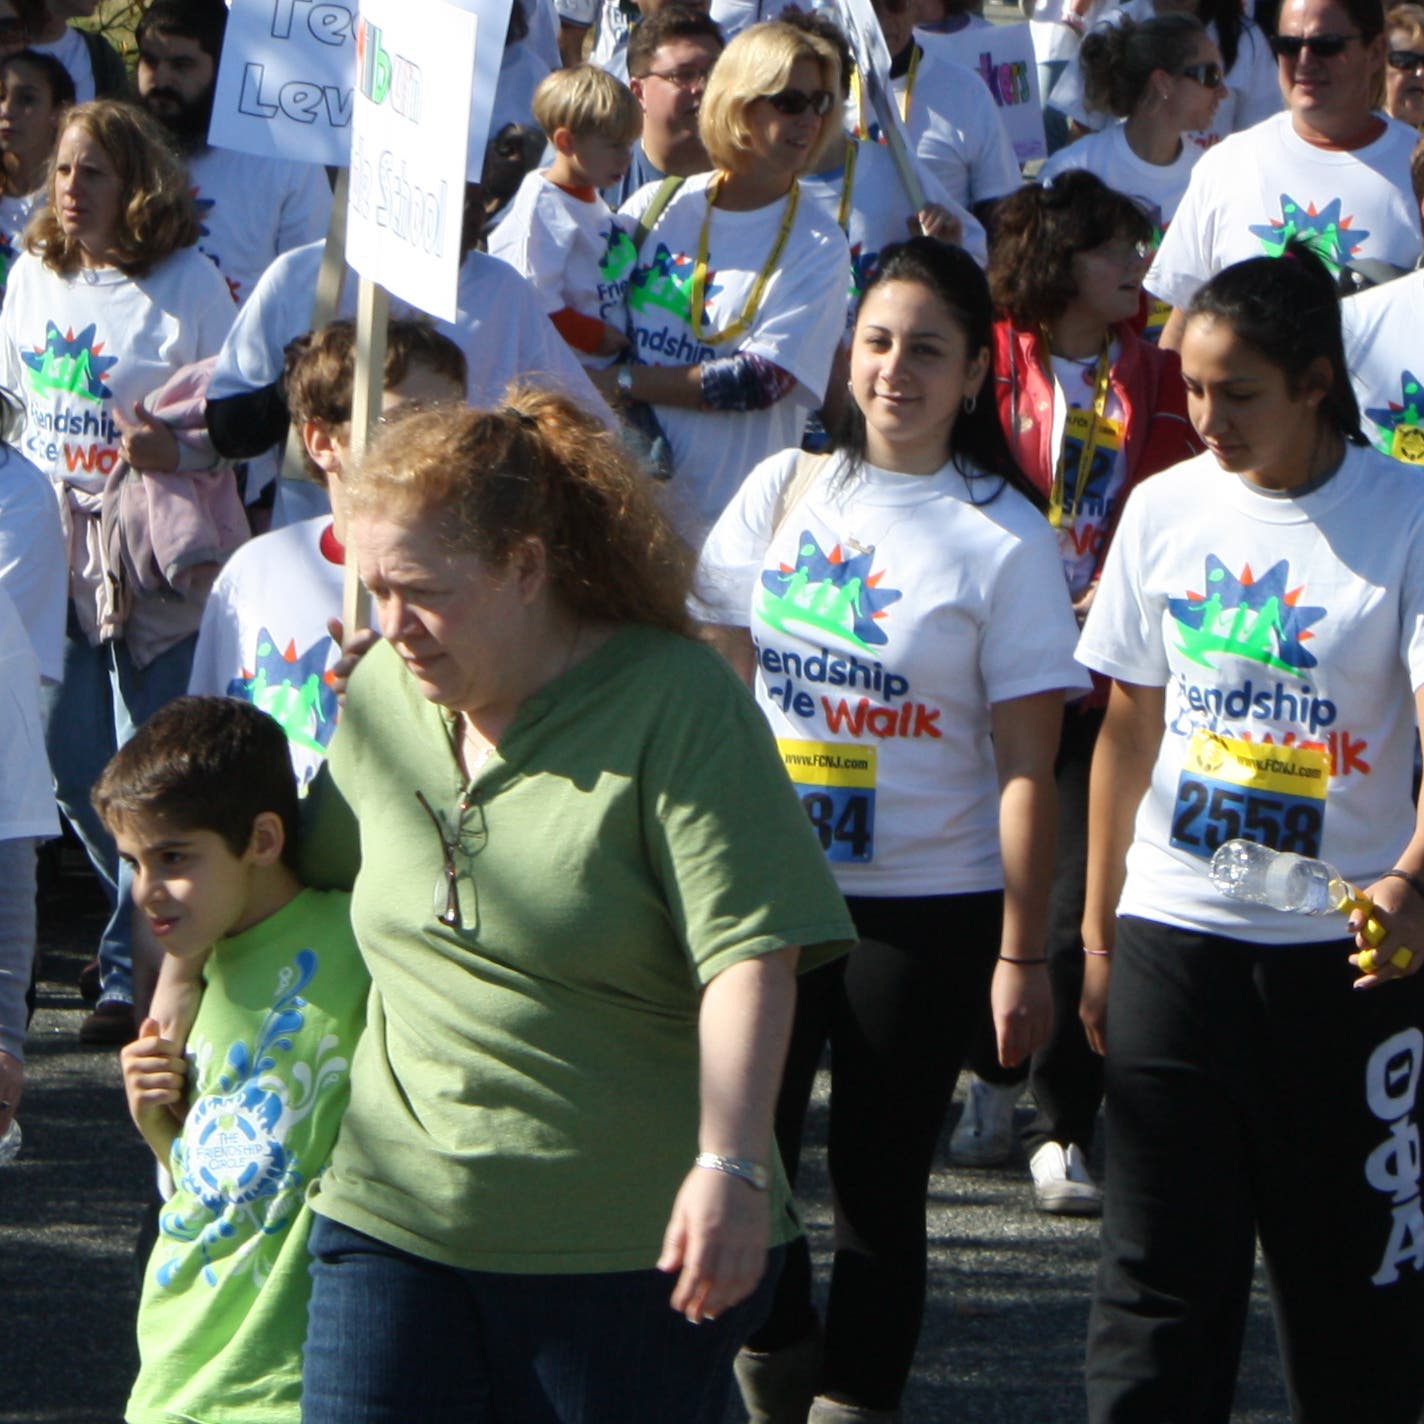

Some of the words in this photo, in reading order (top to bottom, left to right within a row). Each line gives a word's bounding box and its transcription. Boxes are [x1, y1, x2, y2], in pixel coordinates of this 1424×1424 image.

[820, 695, 944, 739] Walk
[784, 752, 869, 771] www.FCNJ.com
[1236, 754, 1323, 779] www.FCNJ.com
[1173, 779, 1320, 859] 2558
